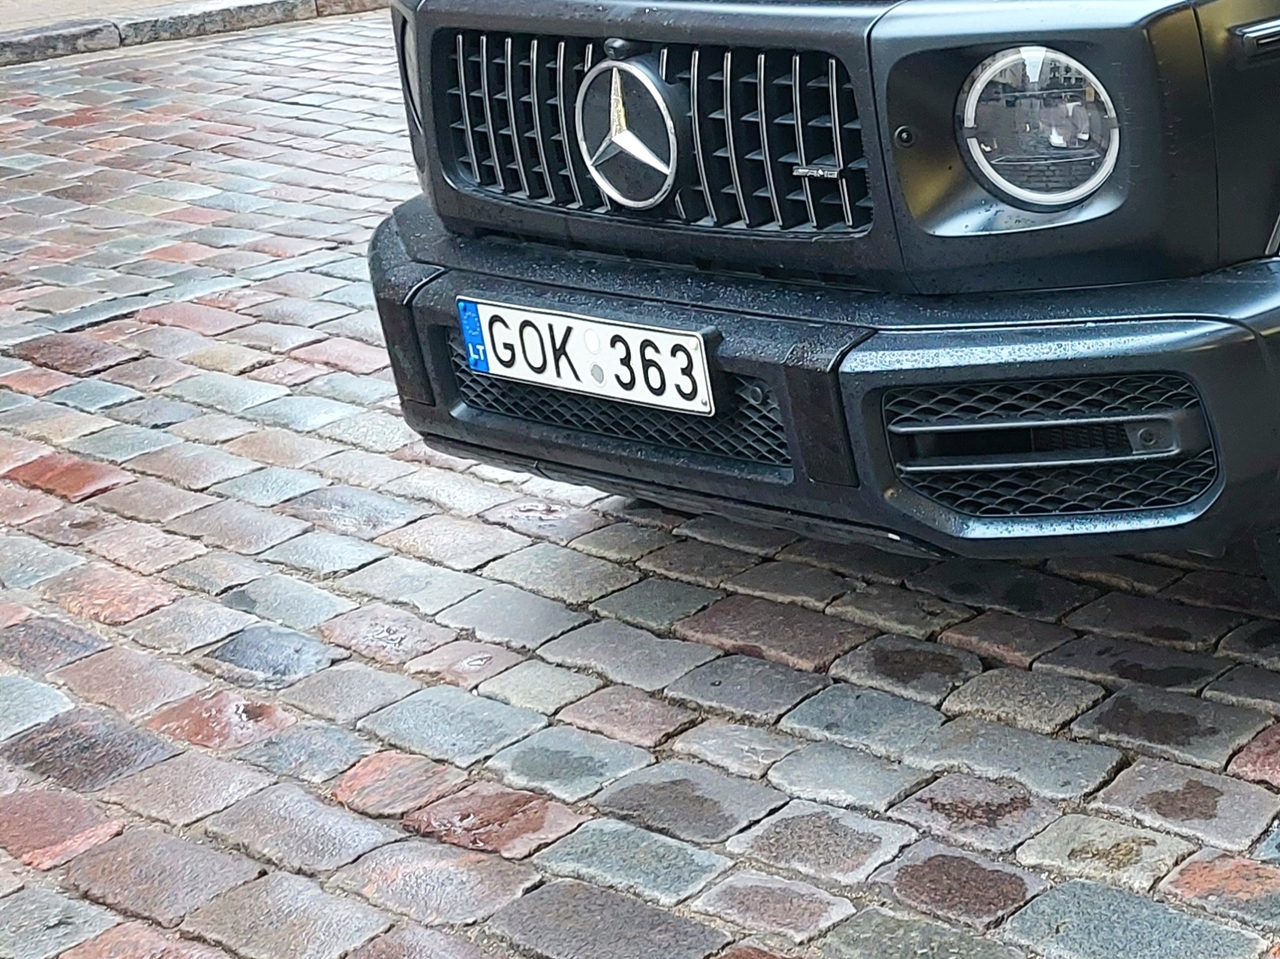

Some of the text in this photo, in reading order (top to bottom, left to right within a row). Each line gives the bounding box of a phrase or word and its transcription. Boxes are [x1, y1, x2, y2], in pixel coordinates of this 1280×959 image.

[468, 343, 485, 361] LT
[488, 314, 698, 401] GOK 363
